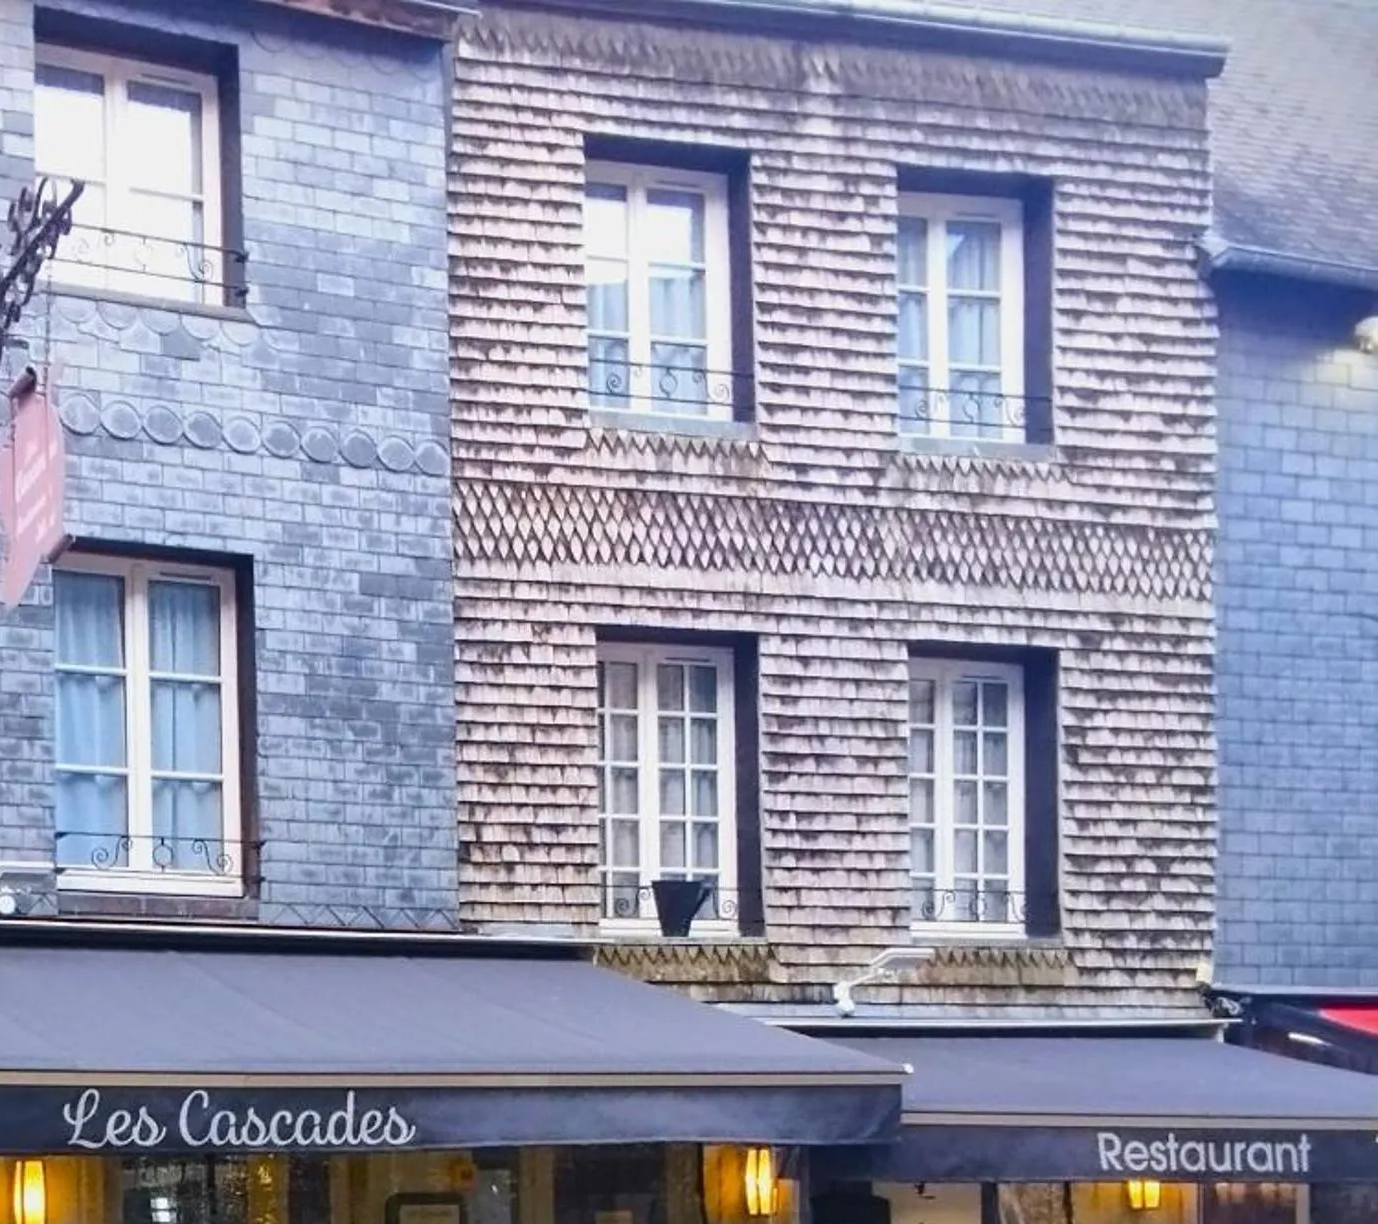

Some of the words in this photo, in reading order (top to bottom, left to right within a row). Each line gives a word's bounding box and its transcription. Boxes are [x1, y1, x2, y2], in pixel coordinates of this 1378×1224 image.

[63, 1088, 167, 1149] Les
[178, 1089, 417, 1147] Cascades
[1096, 1132, 1312, 1173] Restaurant
